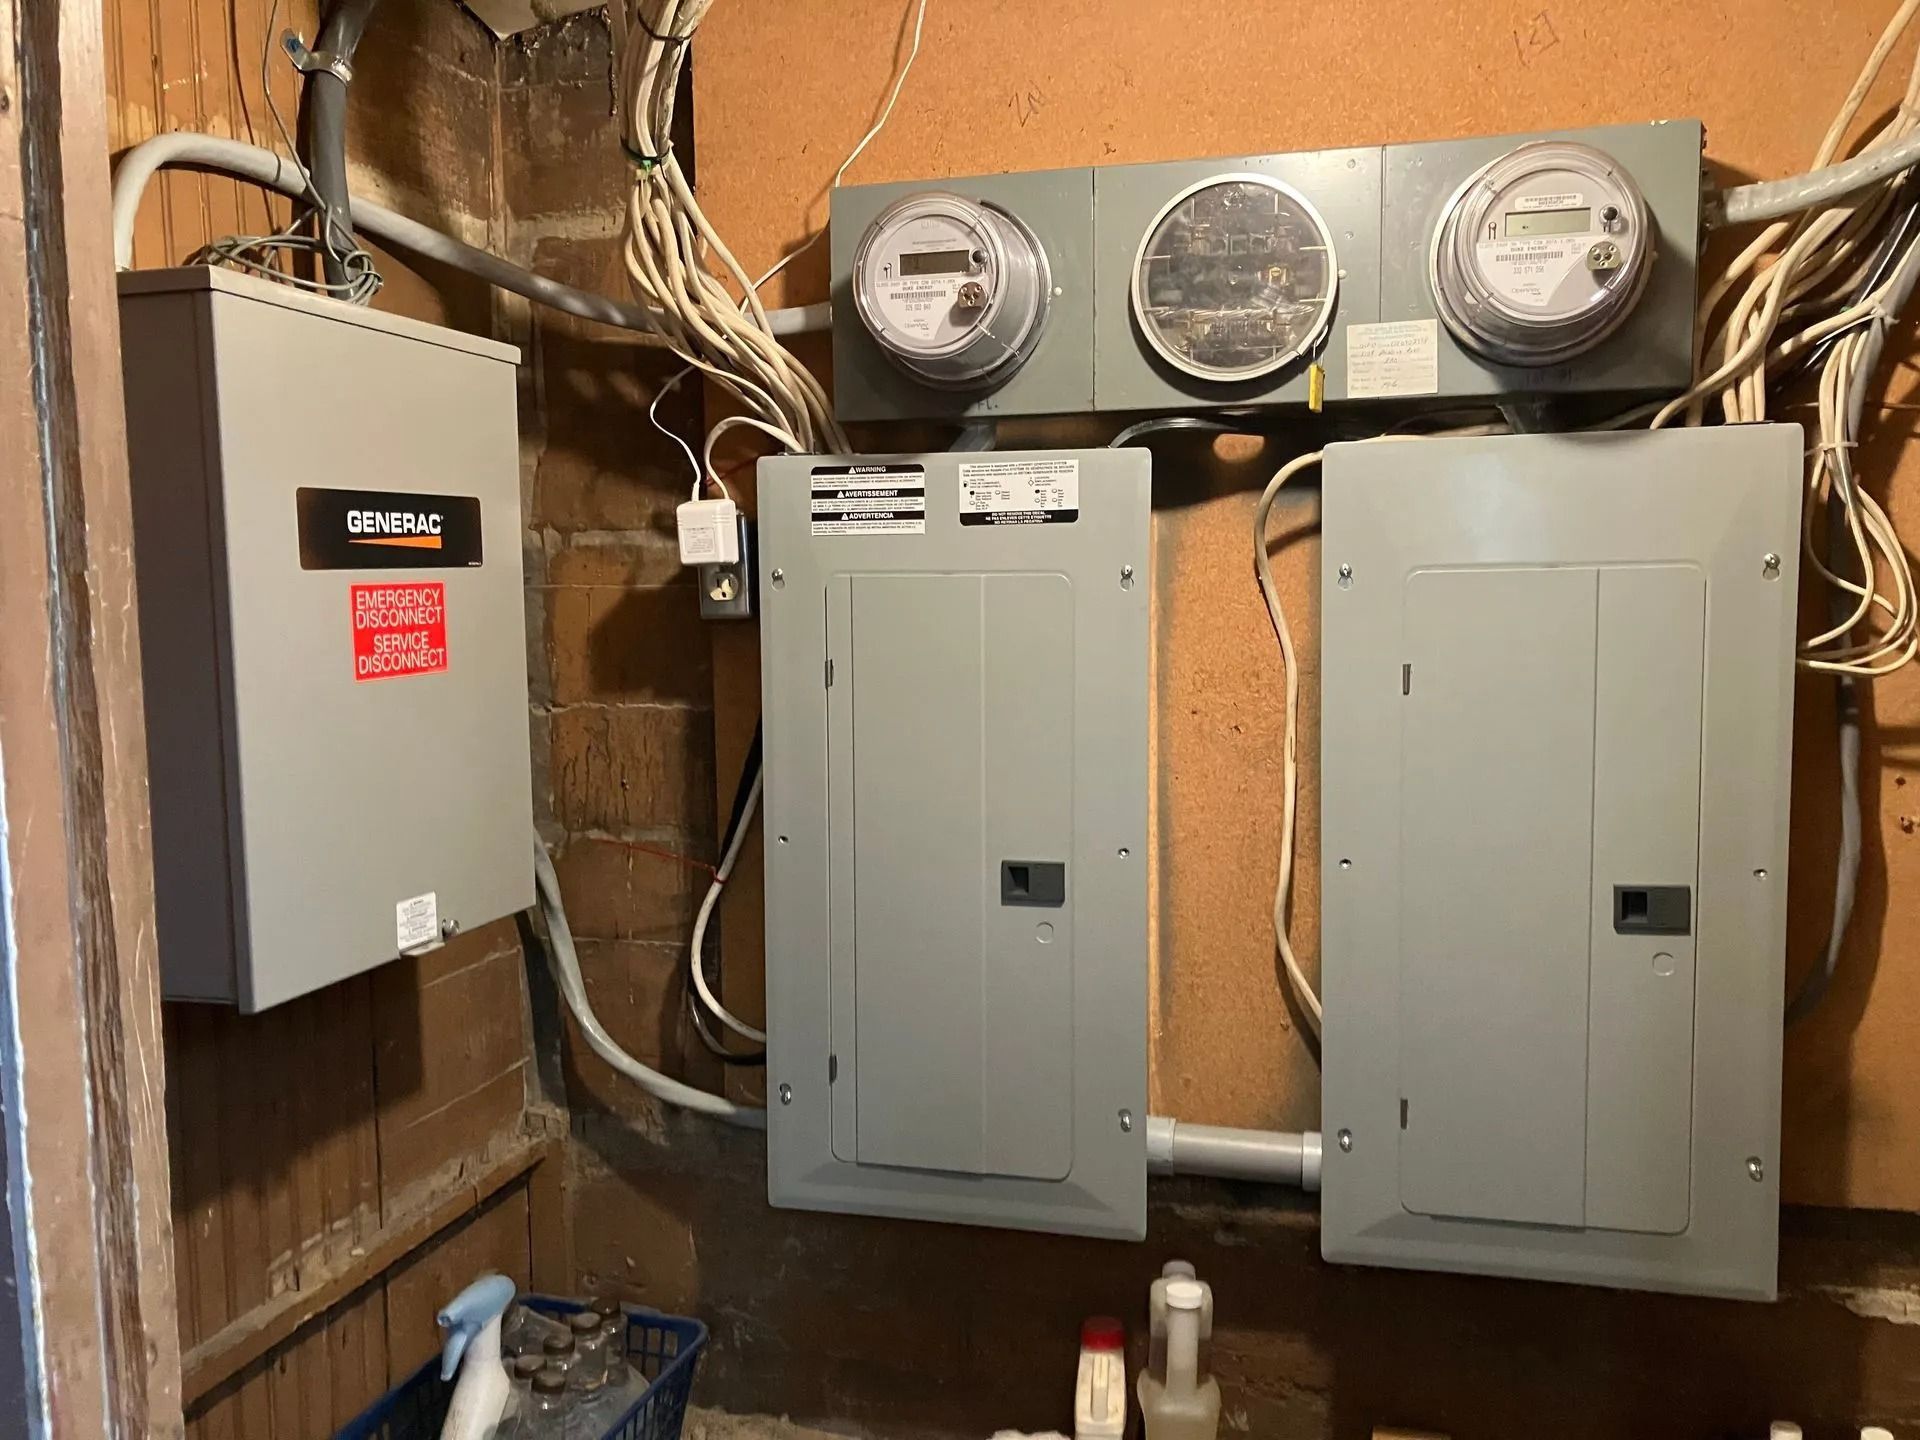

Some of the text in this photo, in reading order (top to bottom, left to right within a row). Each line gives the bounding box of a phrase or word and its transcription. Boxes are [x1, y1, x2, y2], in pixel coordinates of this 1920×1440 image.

[845, 490, 898, 498] AVERTISSEMENT
[347, 510, 442, 534] GENERAC
[849, 512, 894, 520] ADVERTENCIA
[356, 588, 440, 610] EMERGENCY
[356, 606, 442, 629] DISCONNECT
[373, 631, 430, 653] SERVICE
[358, 648, 445, 675] DISCONNECT
